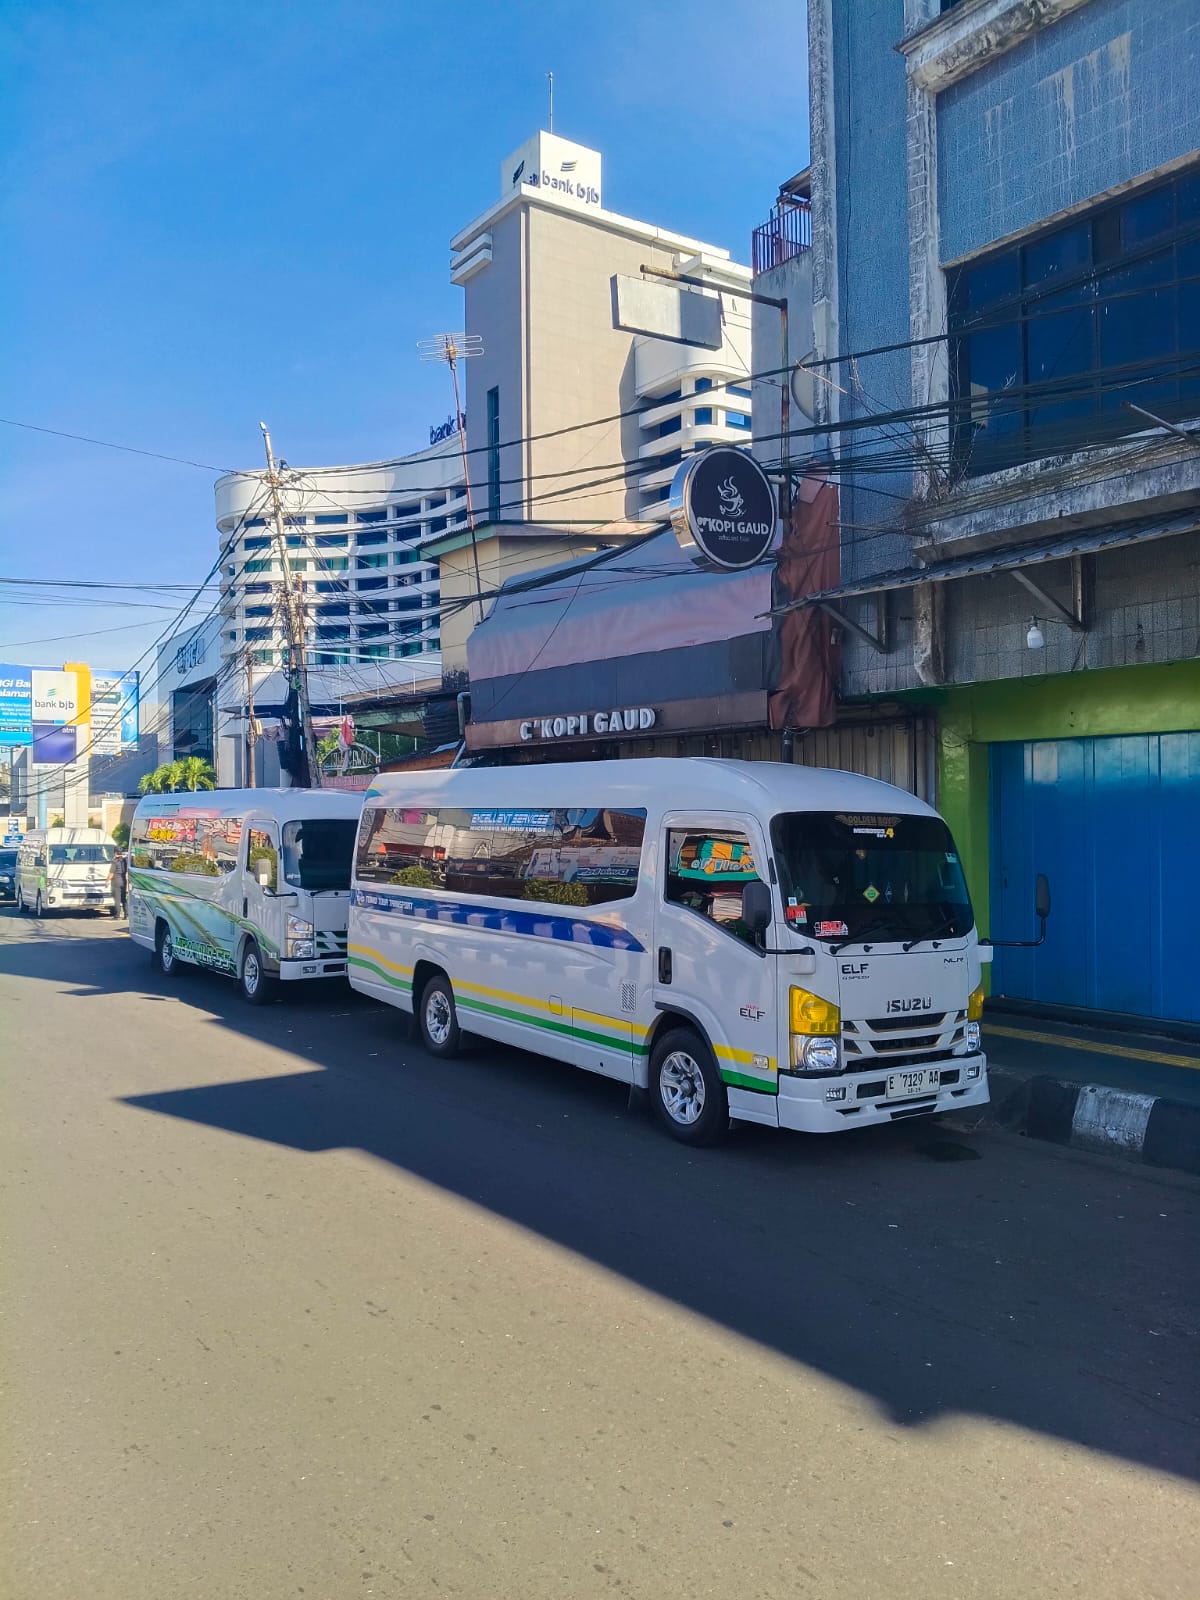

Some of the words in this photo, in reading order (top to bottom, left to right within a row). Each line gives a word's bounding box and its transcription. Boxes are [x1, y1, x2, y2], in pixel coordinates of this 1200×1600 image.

[542, 170, 574, 195] bank
[576, 183, 600, 204] bjb
[737, 521, 769, 535] GAUD
[34, 700, 56, 708] bank
[58, 701, 75, 710] bjb
[593, 708, 656, 733] GAUD
[471, 813, 513, 824] EXCELLENT
[512, 814, 550, 825] SERVICES
[886, 827, 895, 839] 4
[841, 963, 869, 975] ELF
[886, 996, 932, 1013] ISUZU
[739, 1007, 766, 1020] ELF
[889, 1076, 895, 1090] E
[902, 1072, 923, 1088] 7129
[929, 1070, 939, 1085] AA
